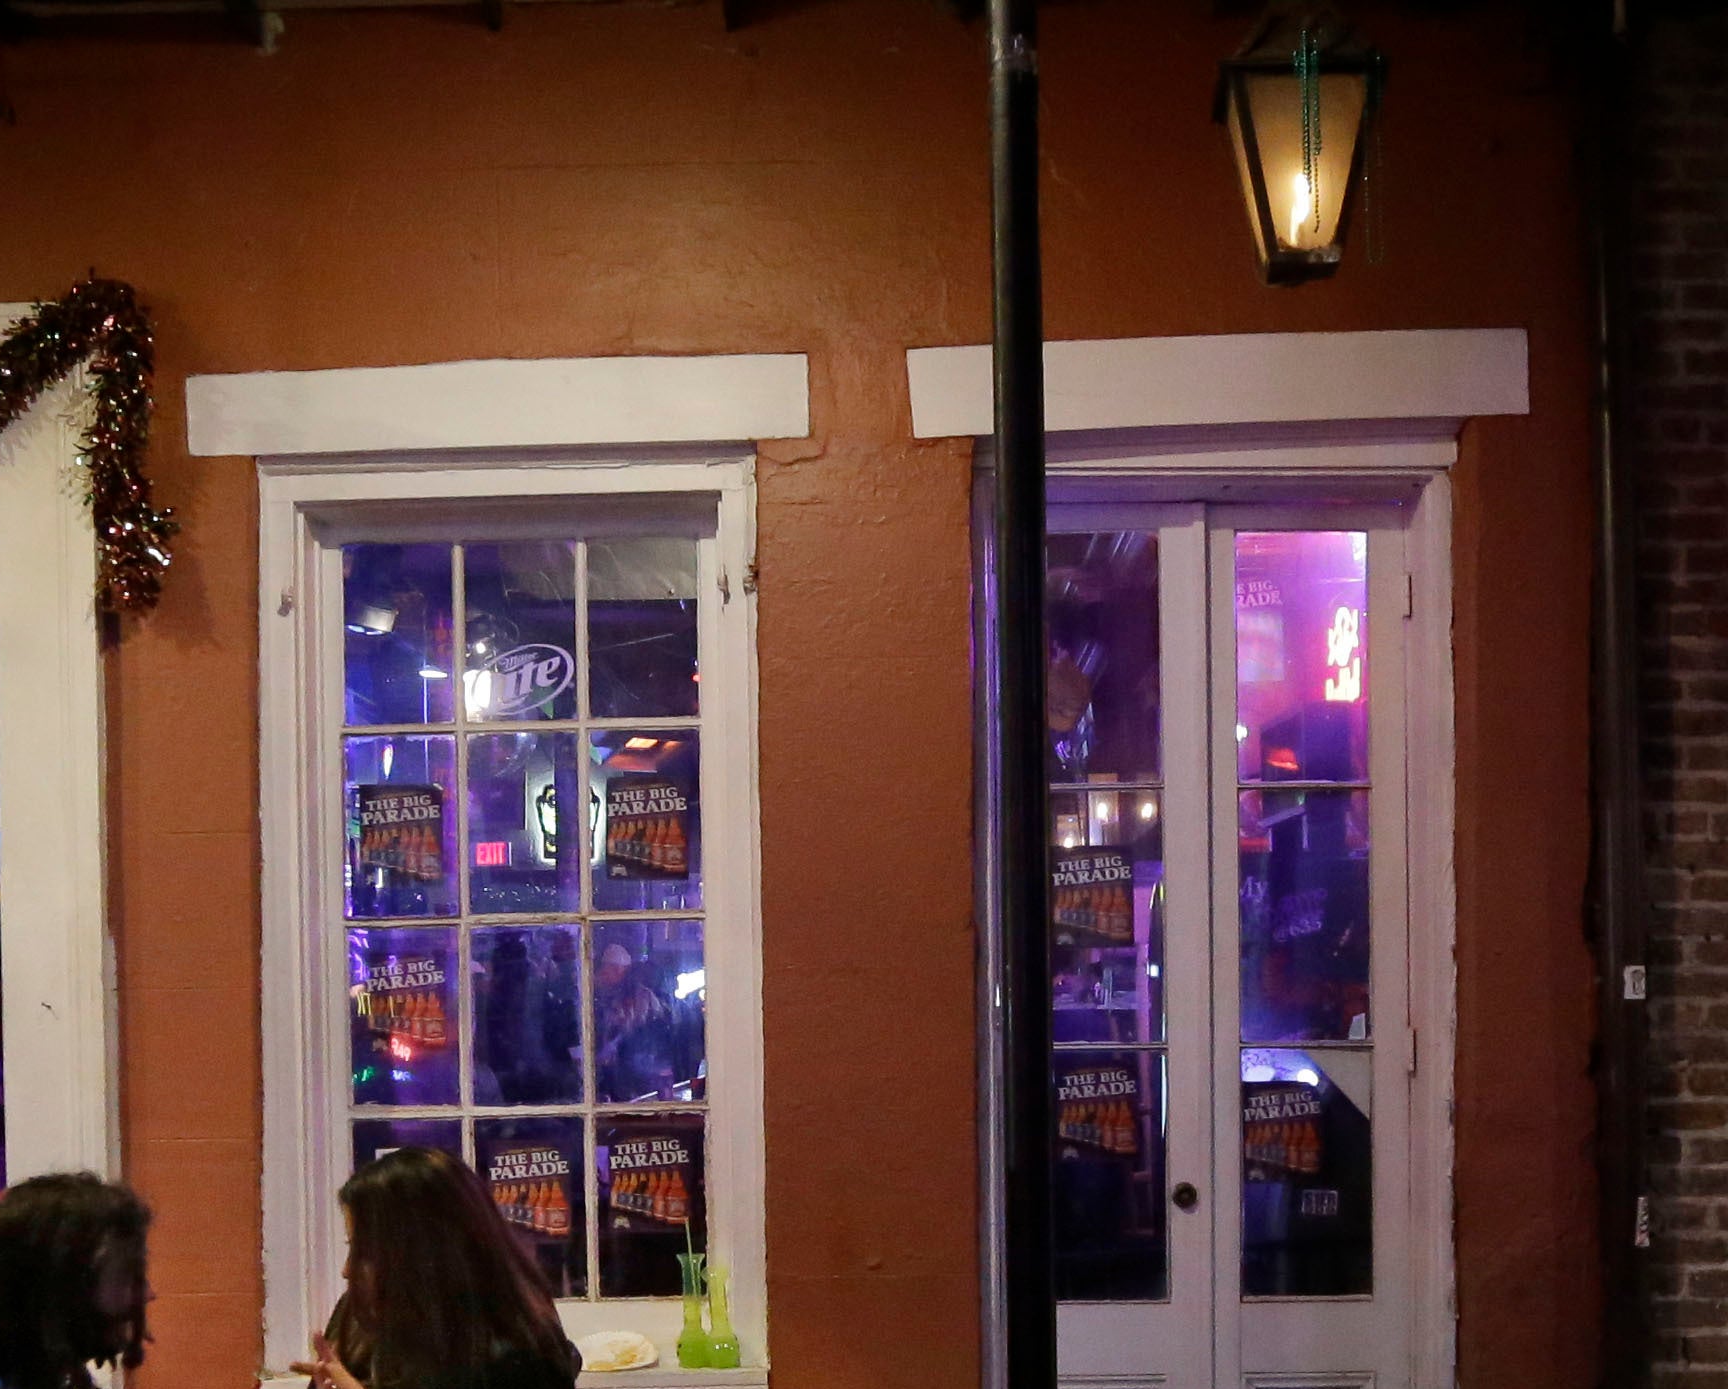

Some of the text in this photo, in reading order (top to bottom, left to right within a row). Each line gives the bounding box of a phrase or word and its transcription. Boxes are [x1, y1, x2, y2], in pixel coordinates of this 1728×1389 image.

[365, 794, 432, 812] THE BIG
[610, 786, 678, 803] THE BIG
[361, 805, 441, 825] PARADE
[607, 796, 687, 816] PARADE
[476, 842, 505, 865] EXIT
[1057, 856, 1123, 873] THE BIG
[1052, 866, 1132, 886] PARADE
[370, 960, 436, 977] THE BIG
[365, 970, 446, 992] PARADE
[1063, 1070, 1128, 1087] THE BIG
[1057, 1080, 1136, 1100] PARADE
[1248, 1090, 1313, 1108] THE BIG
[1243, 1101, 1322, 1122] PARADE
[615, 1138, 681, 1156] THE BIG
[494, 1149, 560, 1167] THE BIG
[610, 1149, 690, 1170] PARADE
[489, 1160, 570, 1181] PARADE
